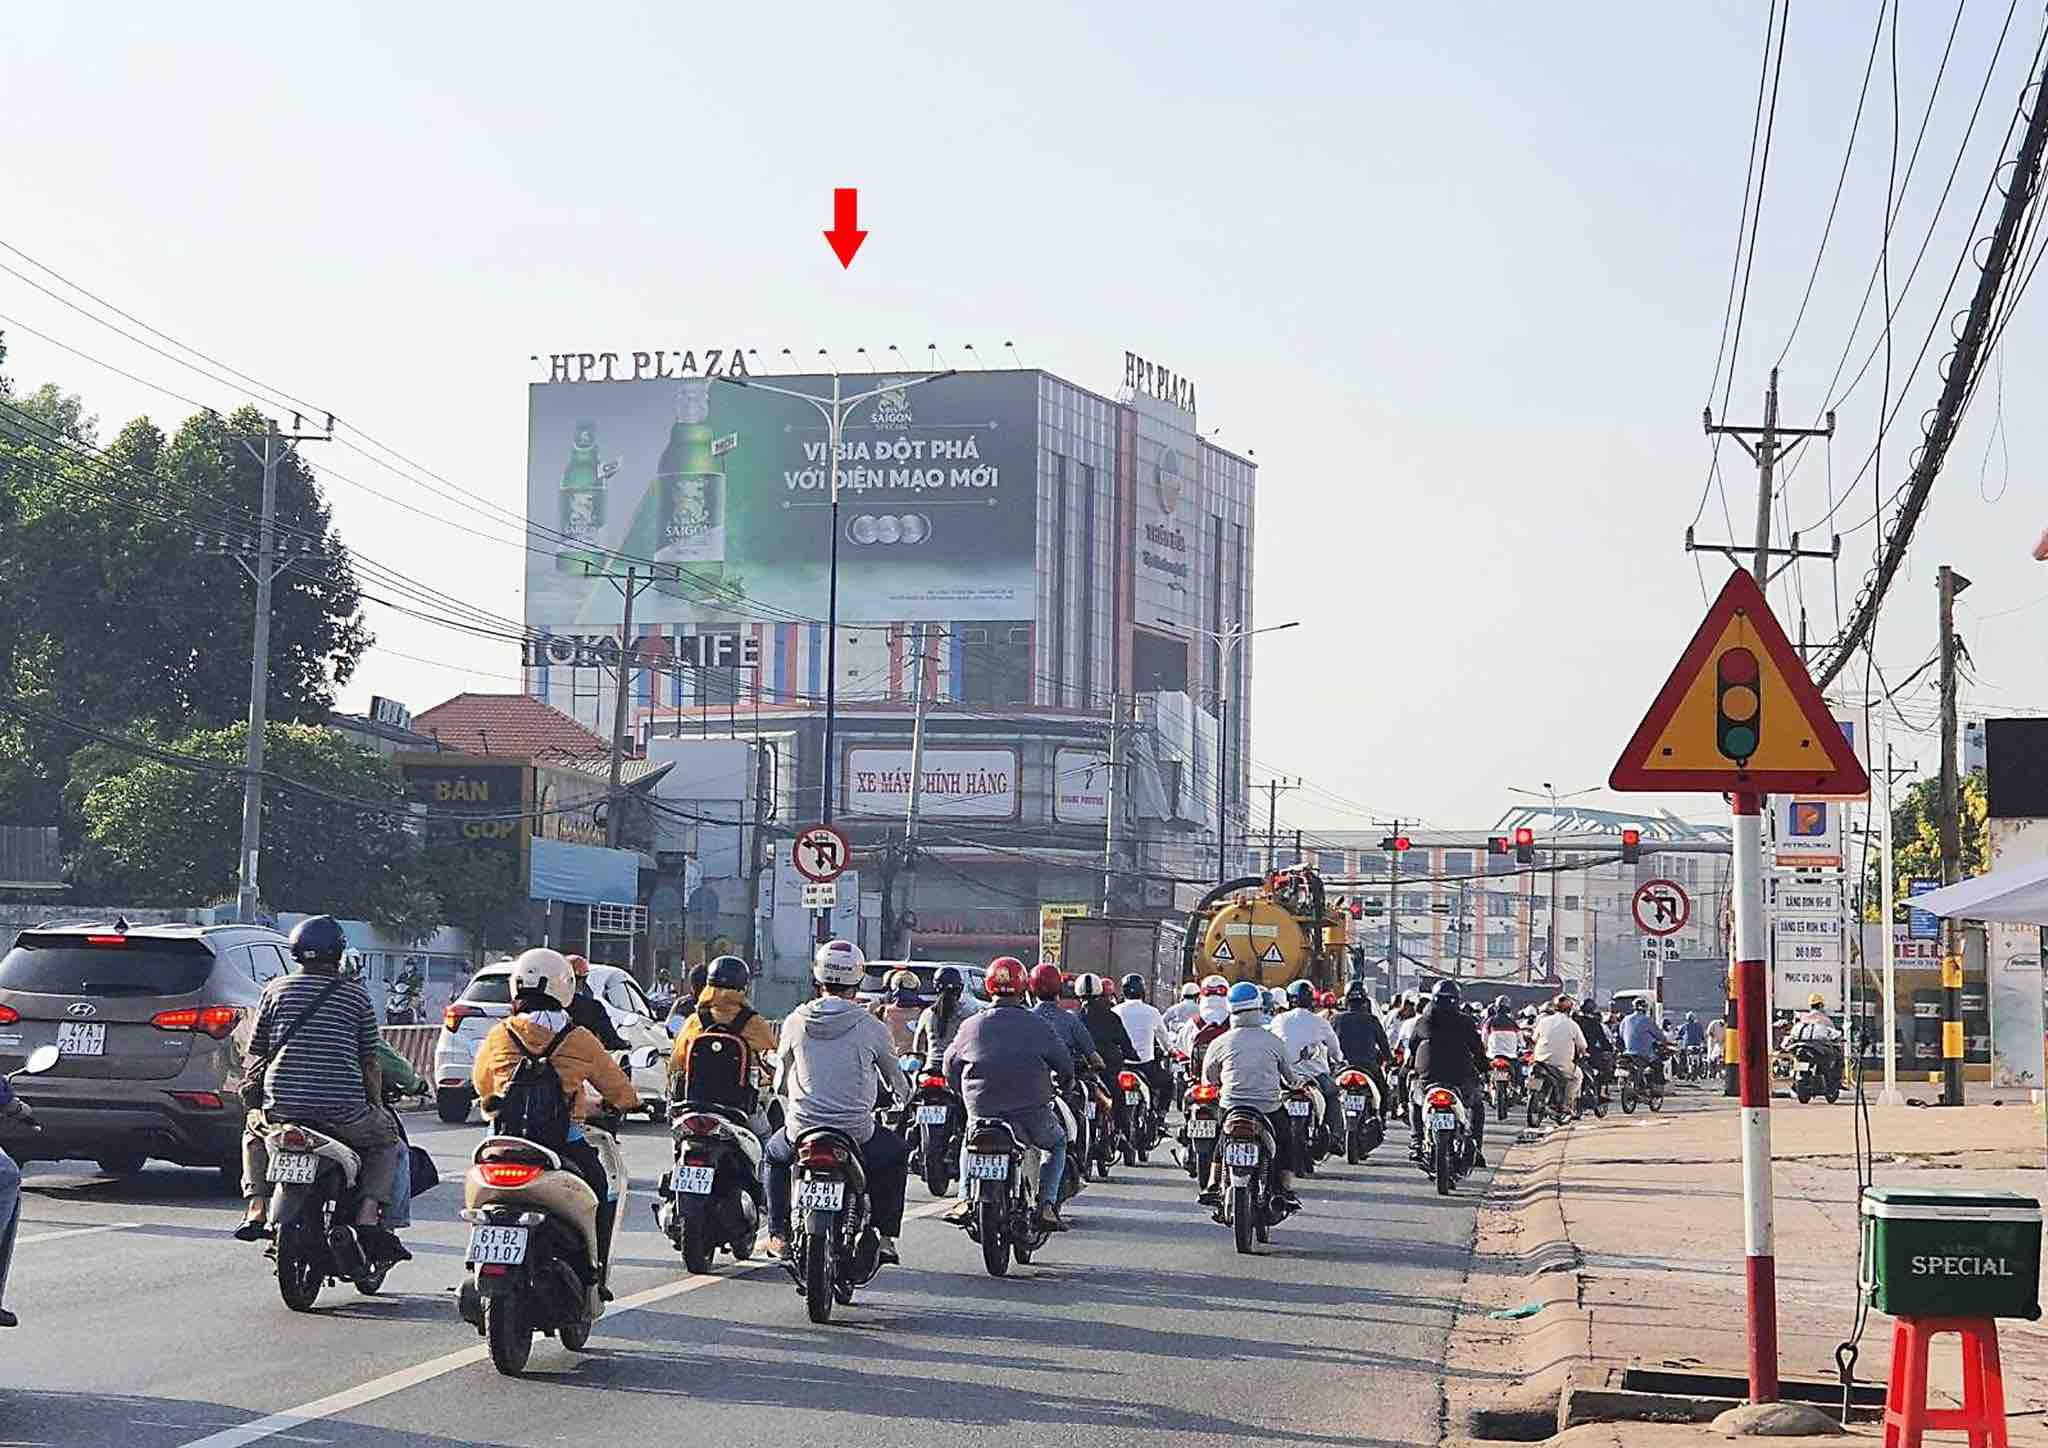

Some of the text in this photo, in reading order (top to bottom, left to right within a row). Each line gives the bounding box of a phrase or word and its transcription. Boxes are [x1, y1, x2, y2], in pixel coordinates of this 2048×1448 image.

[549, 349, 755, 383] HPT PLAZA
[1125, 350, 1197, 416] HPT PLAZA
[802, 435, 980, 466] VỊ BIA ĐỘT PHÁ
[783, 467, 825, 490] VỚI
[889, 470, 945, 493] MẠO
[950, 464, 999, 488] MỚI
[674, 635, 758, 667] LIFE
[857, 771, 877, 793] XE
[1911, 1256, 2014, 1276] SPECIAL
